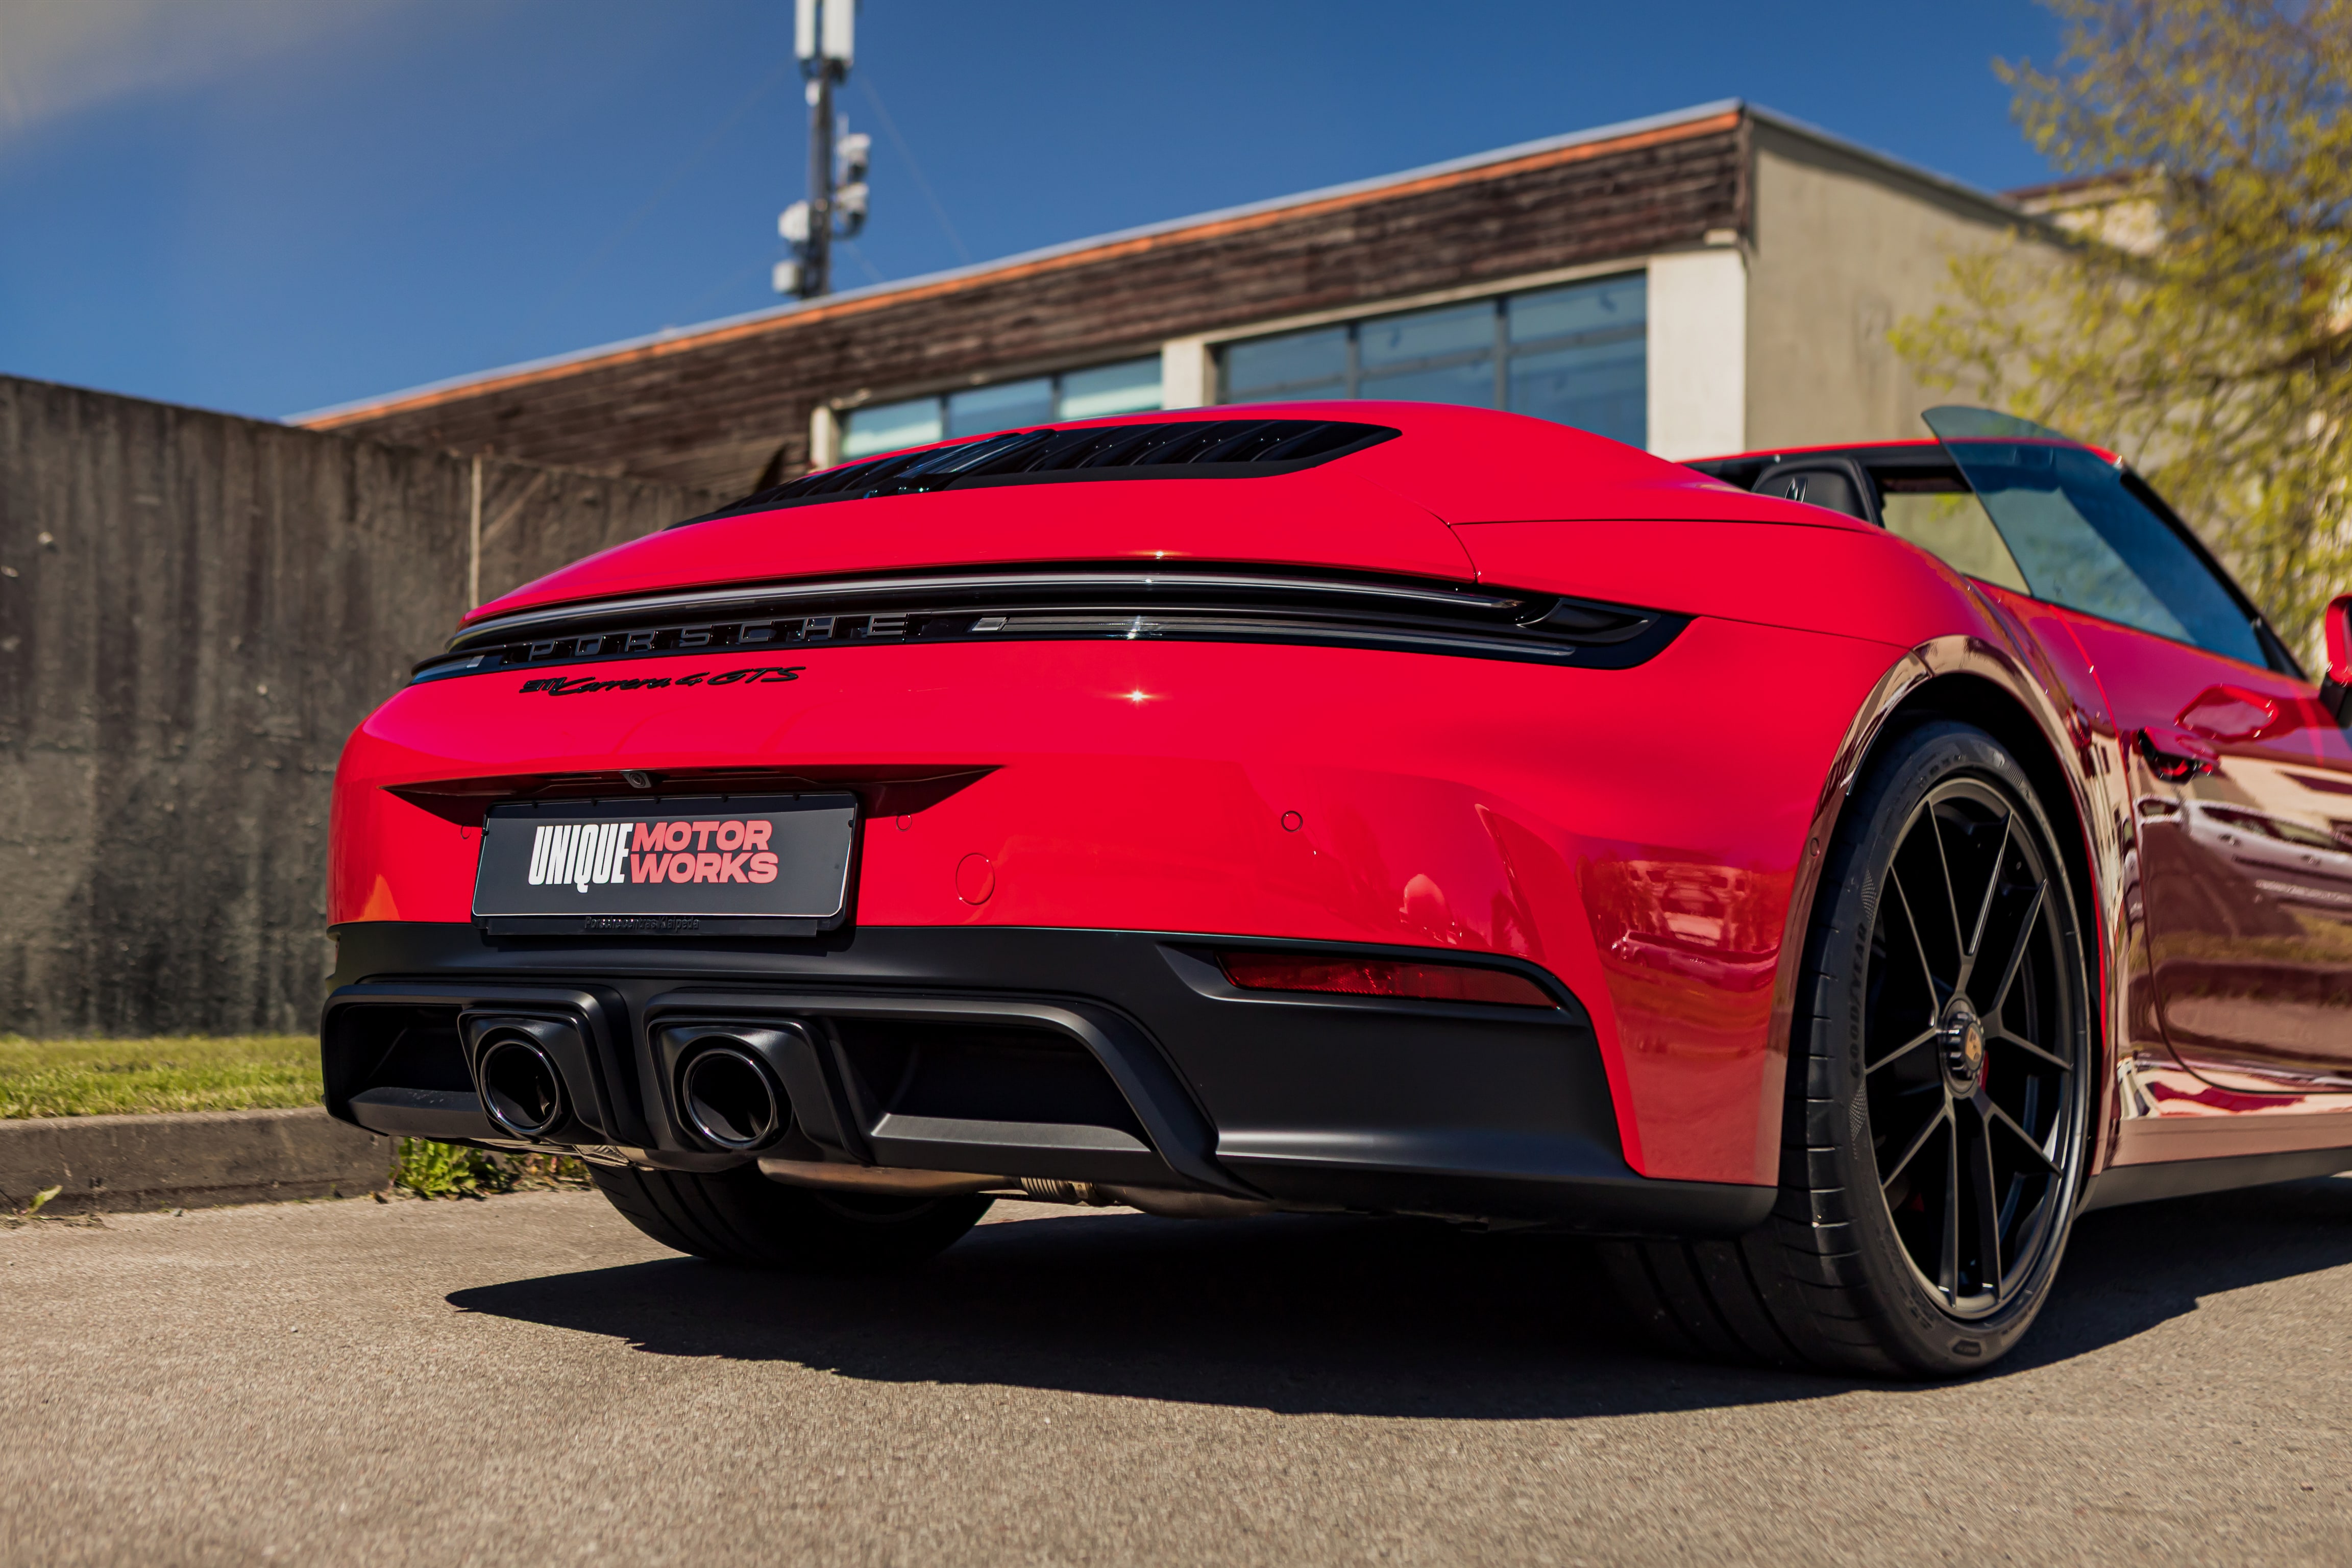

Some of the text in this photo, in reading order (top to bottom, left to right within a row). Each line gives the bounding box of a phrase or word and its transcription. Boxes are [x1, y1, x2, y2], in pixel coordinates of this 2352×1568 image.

[528, 613, 909, 662] PORSCHE
[519, 666, 806, 696] 911 Carrera 4 GTS
[631, 820, 773, 852] MOTOR
[528, 822, 634, 893] UNIQUE
[630, 851, 779, 884] WORKS
[584, 916, 621, 929] Porsche
[1849, 922, 1867, 1079] GOODYEAR
